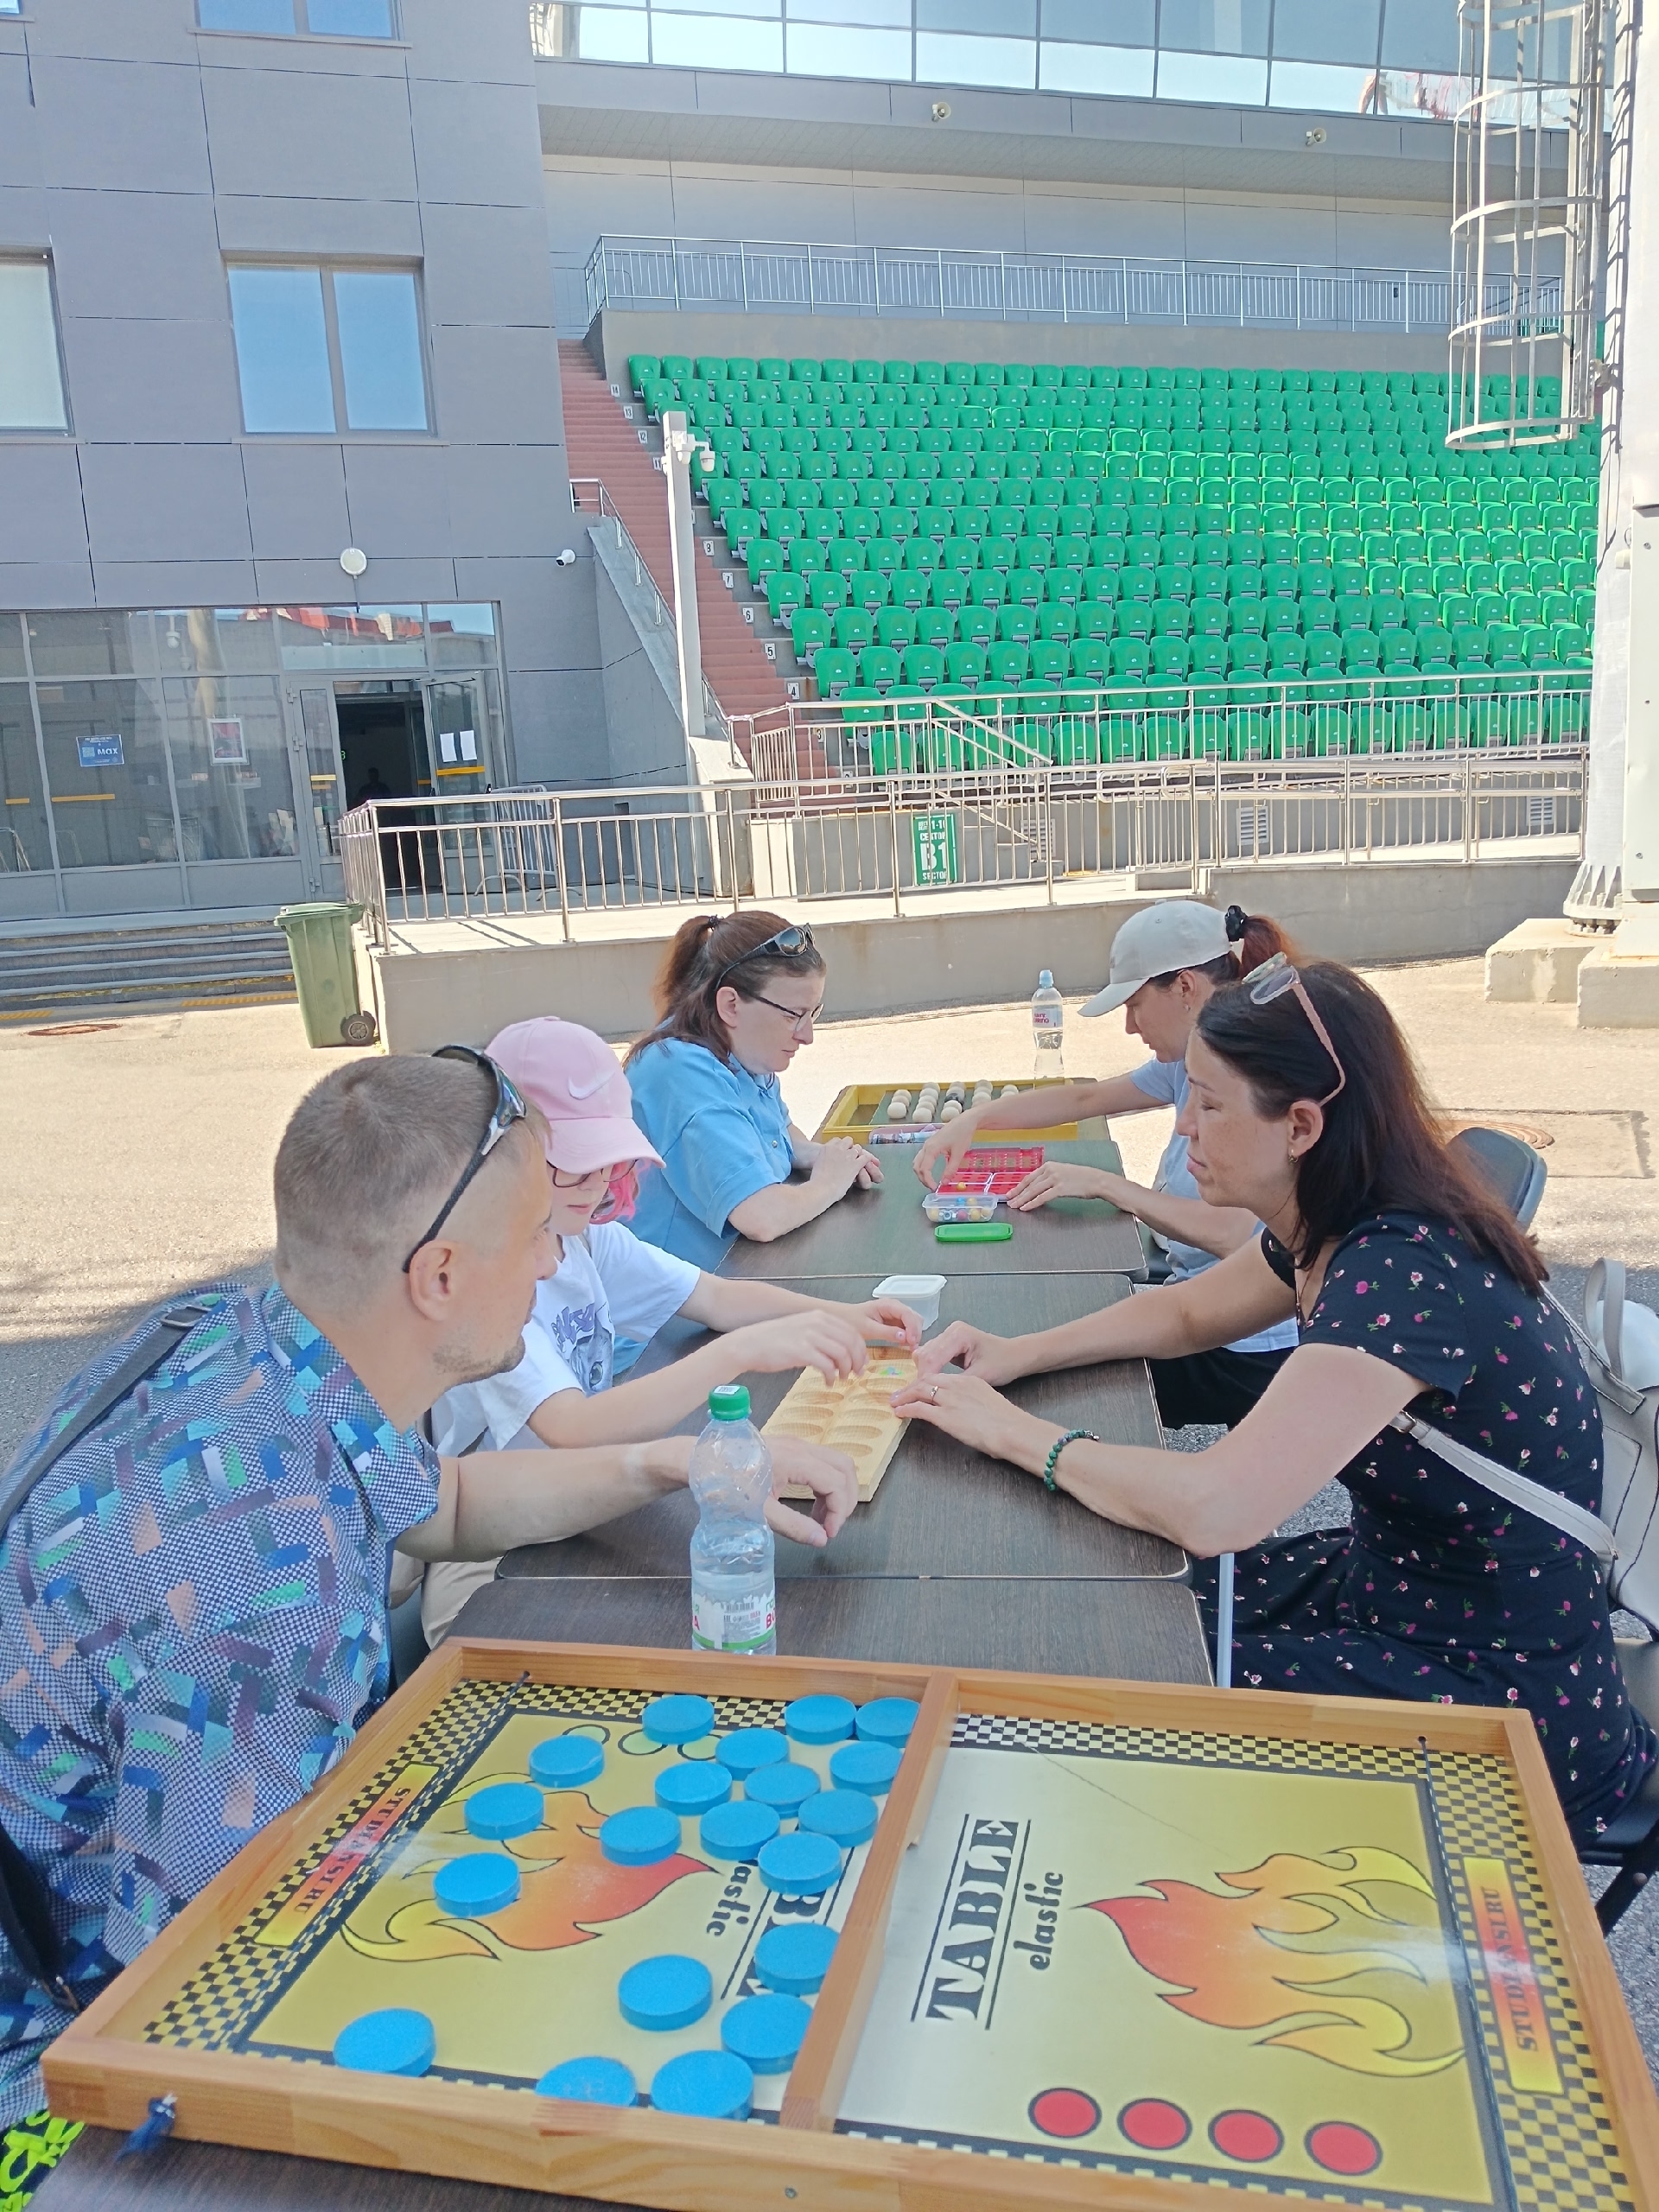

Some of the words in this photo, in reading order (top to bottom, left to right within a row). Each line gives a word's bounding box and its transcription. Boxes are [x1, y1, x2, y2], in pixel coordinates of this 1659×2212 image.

[705, 1859, 760, 1937] astic
[925, 1818, 1019, 2021] TABLE
[1012, 1871, 1064, 1971] elastic
